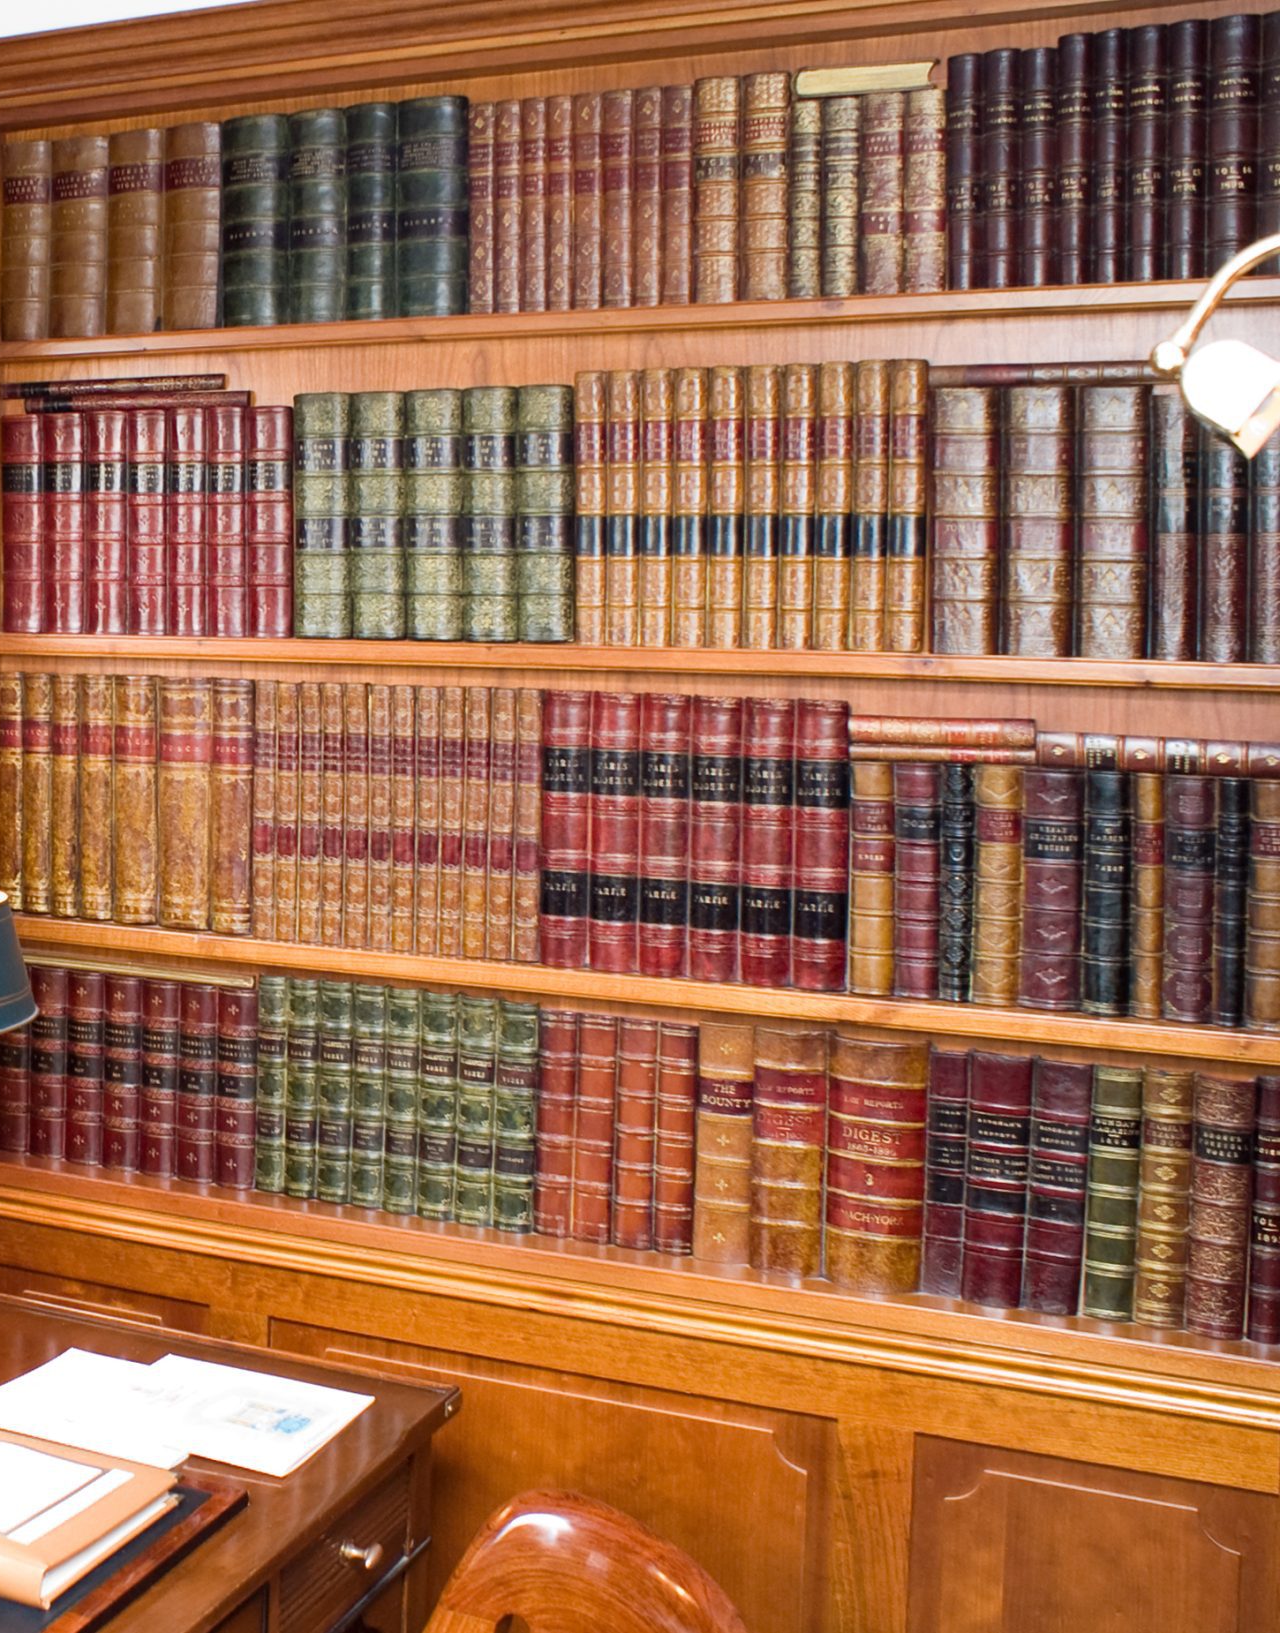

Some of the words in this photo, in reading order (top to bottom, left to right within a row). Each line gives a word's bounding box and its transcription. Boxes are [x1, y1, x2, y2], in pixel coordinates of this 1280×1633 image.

[712, 1083, 736, 1095] THE
[701, 1094, 752, 1108] BOUNTY
[863, 1099, 904, 1110] REPORTS
[842, 1126, 900, 1145] DIGEST
